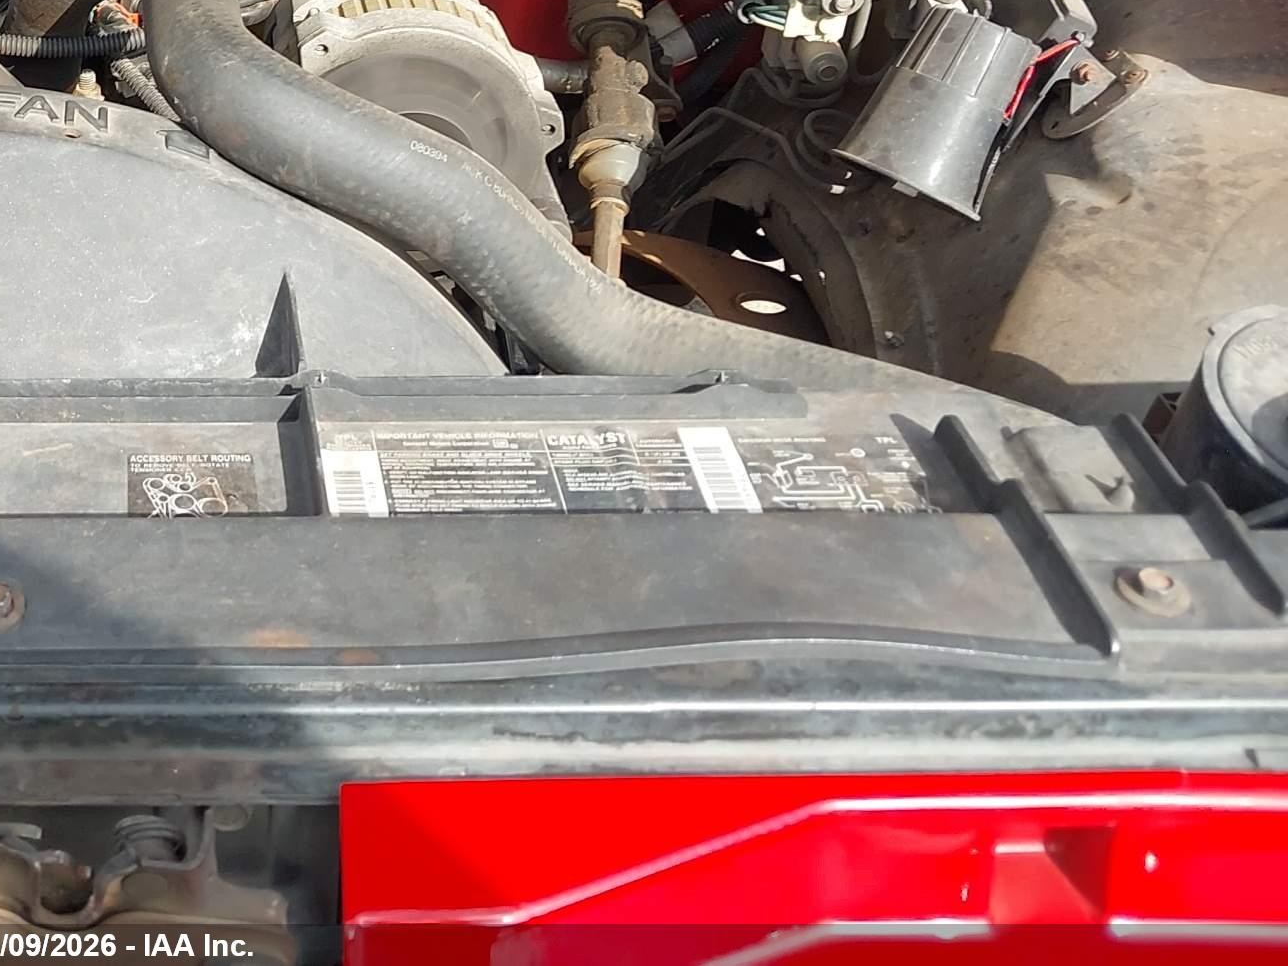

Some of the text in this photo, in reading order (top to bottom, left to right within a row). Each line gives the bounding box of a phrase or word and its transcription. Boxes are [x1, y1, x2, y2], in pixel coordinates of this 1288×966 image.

[377, 432, 431, 440] IMPORTANT
[474, 432, 539, 440] INFORMATION
[547, 432, 627, 446] CATALYST
[130, 454, 251, 463] ACCESSORY BELT ROUTING
